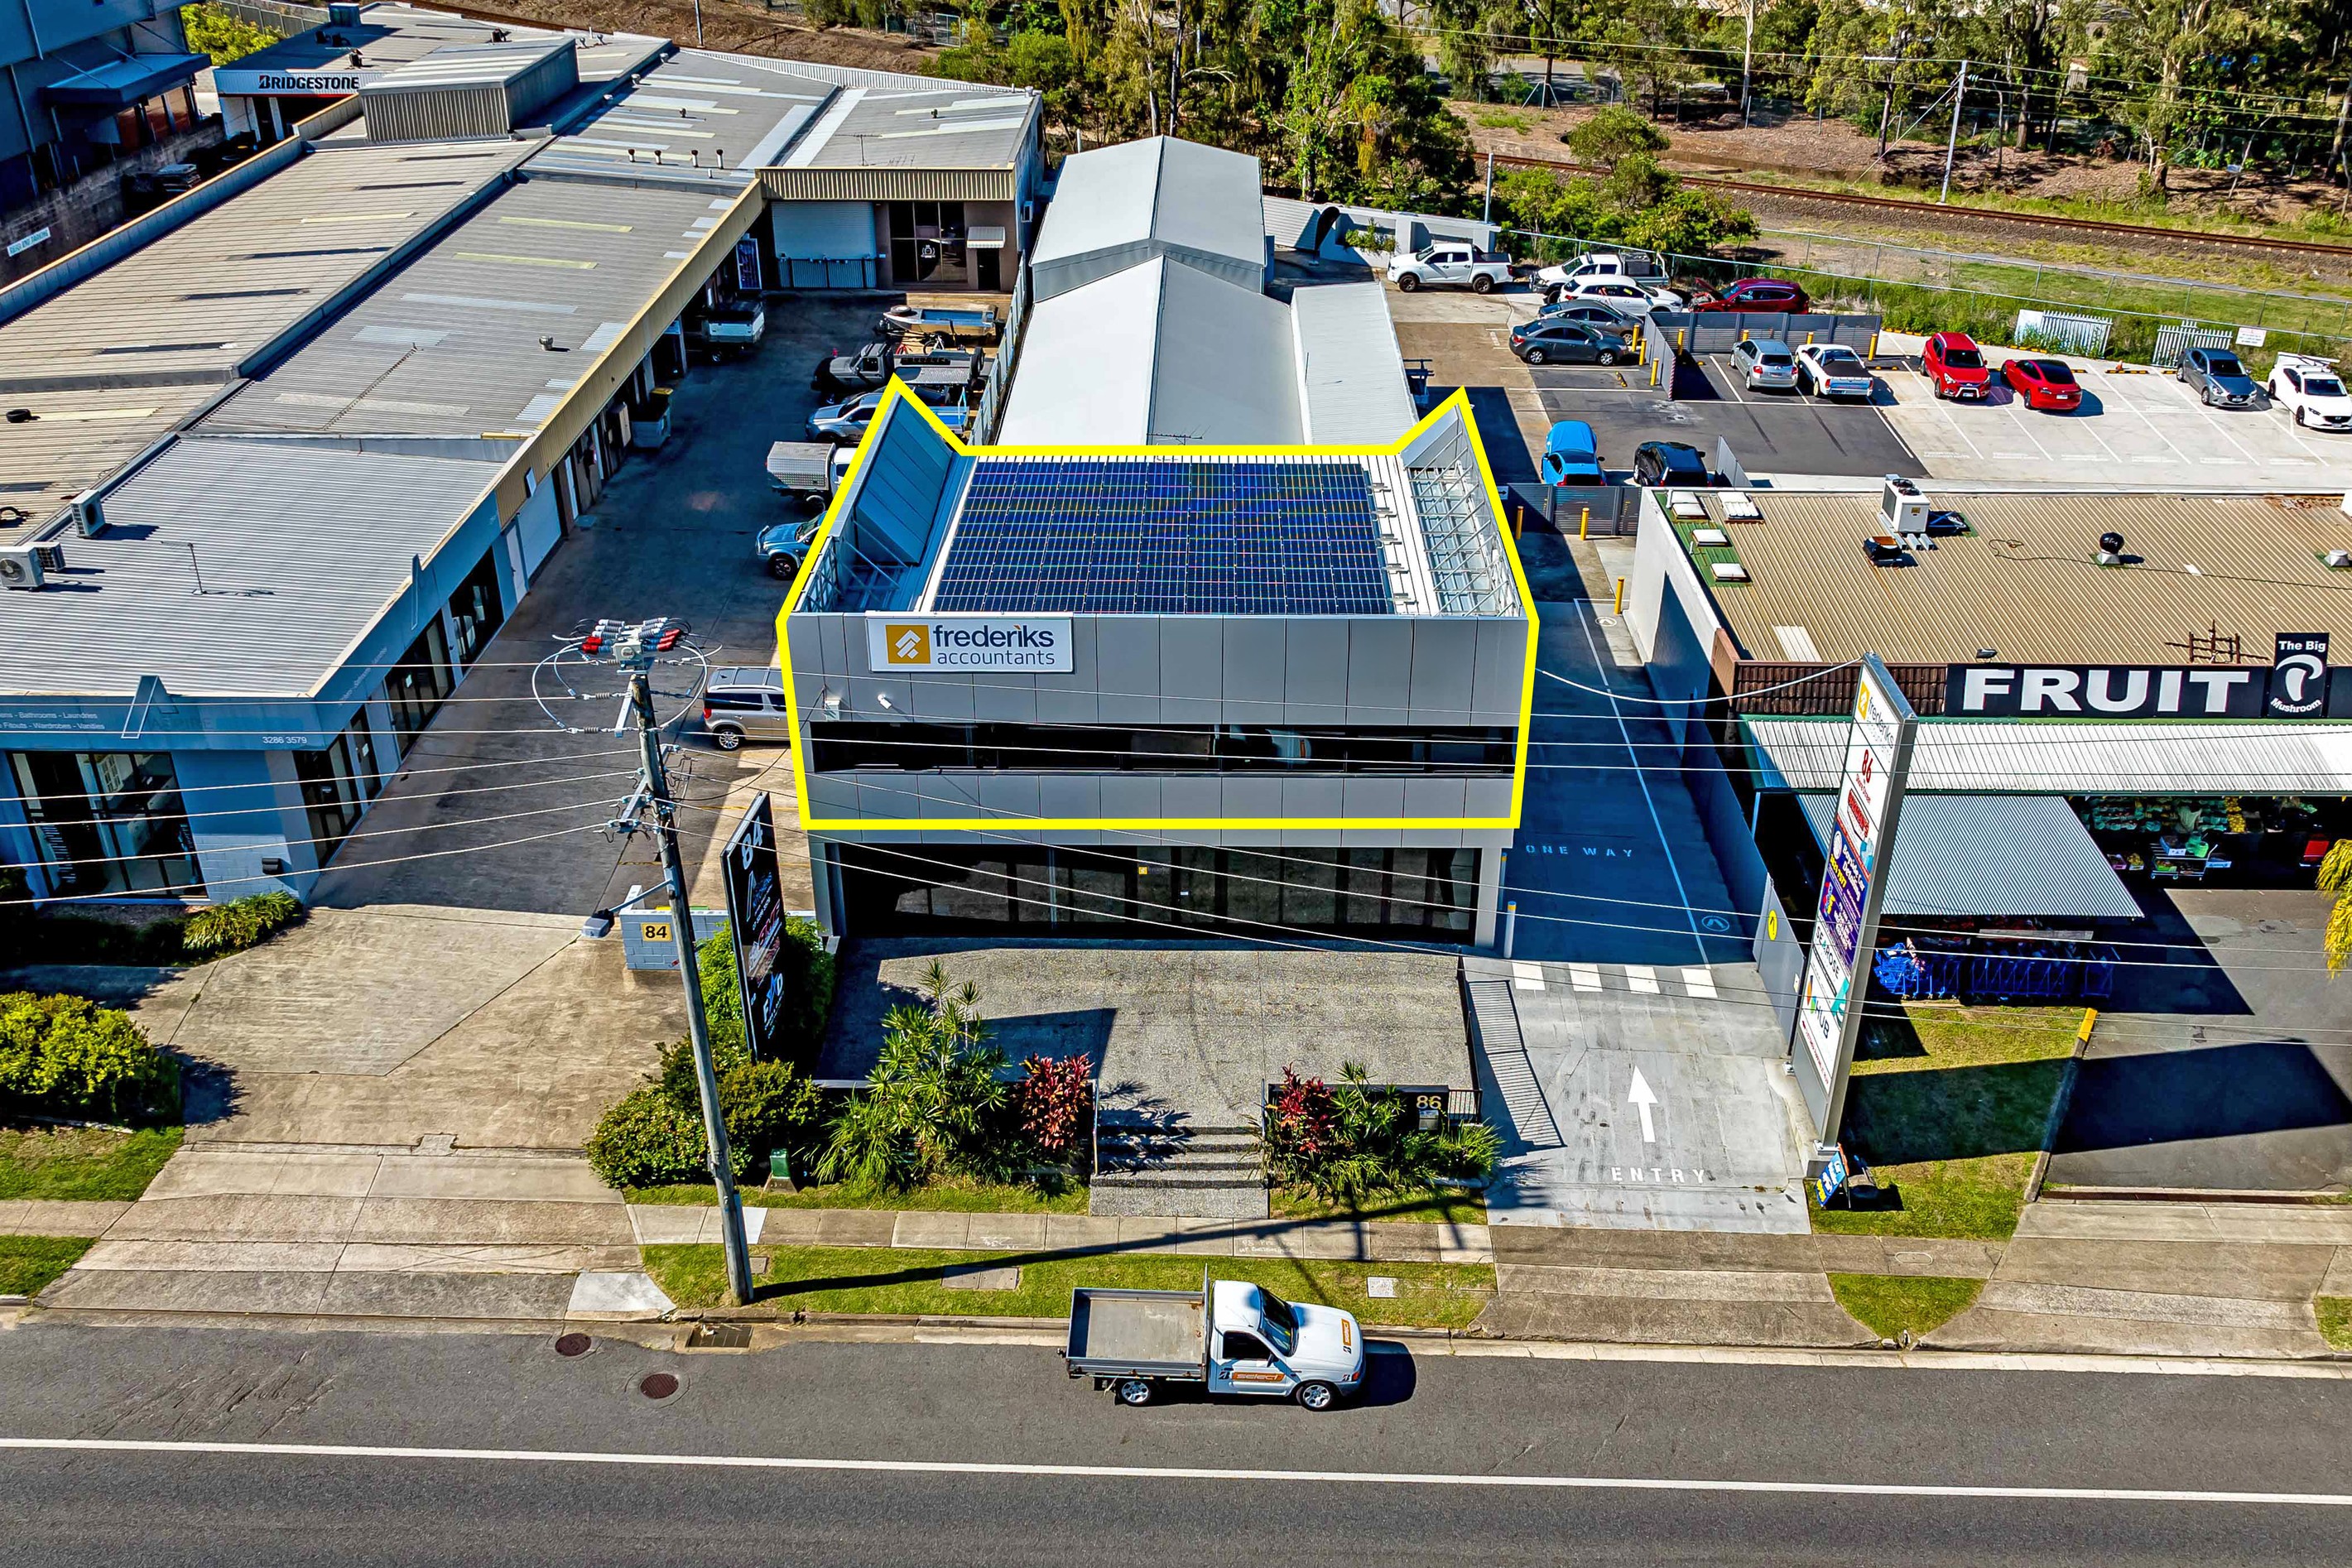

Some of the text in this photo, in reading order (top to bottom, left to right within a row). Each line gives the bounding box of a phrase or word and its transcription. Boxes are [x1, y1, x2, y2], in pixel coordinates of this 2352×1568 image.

[258, 75, 359, 89] BRIDGESTONE
[933, 625, 1055, 647] frederiks
[2278, 641, 2326, 652] The Big
[937, 650, 1056, 665] accountants
[1963, 669, 2249, 713] FRUIT
[2270, 697, 2322, 713] Mushroom
[286, 736, 307, 744] 3579
[1861, 748, 1873, 784] 86
[741, 815, 763, 870] 84
[1526, 844, 1632, 858] ONE WAY
[645, 925, 667, 939] 84
[1815, 1000, 1830, 1040] HUB
[1416, 1094, 1442, 1109] 86
[1610, 1166, 1705, 1184] ENTRY
